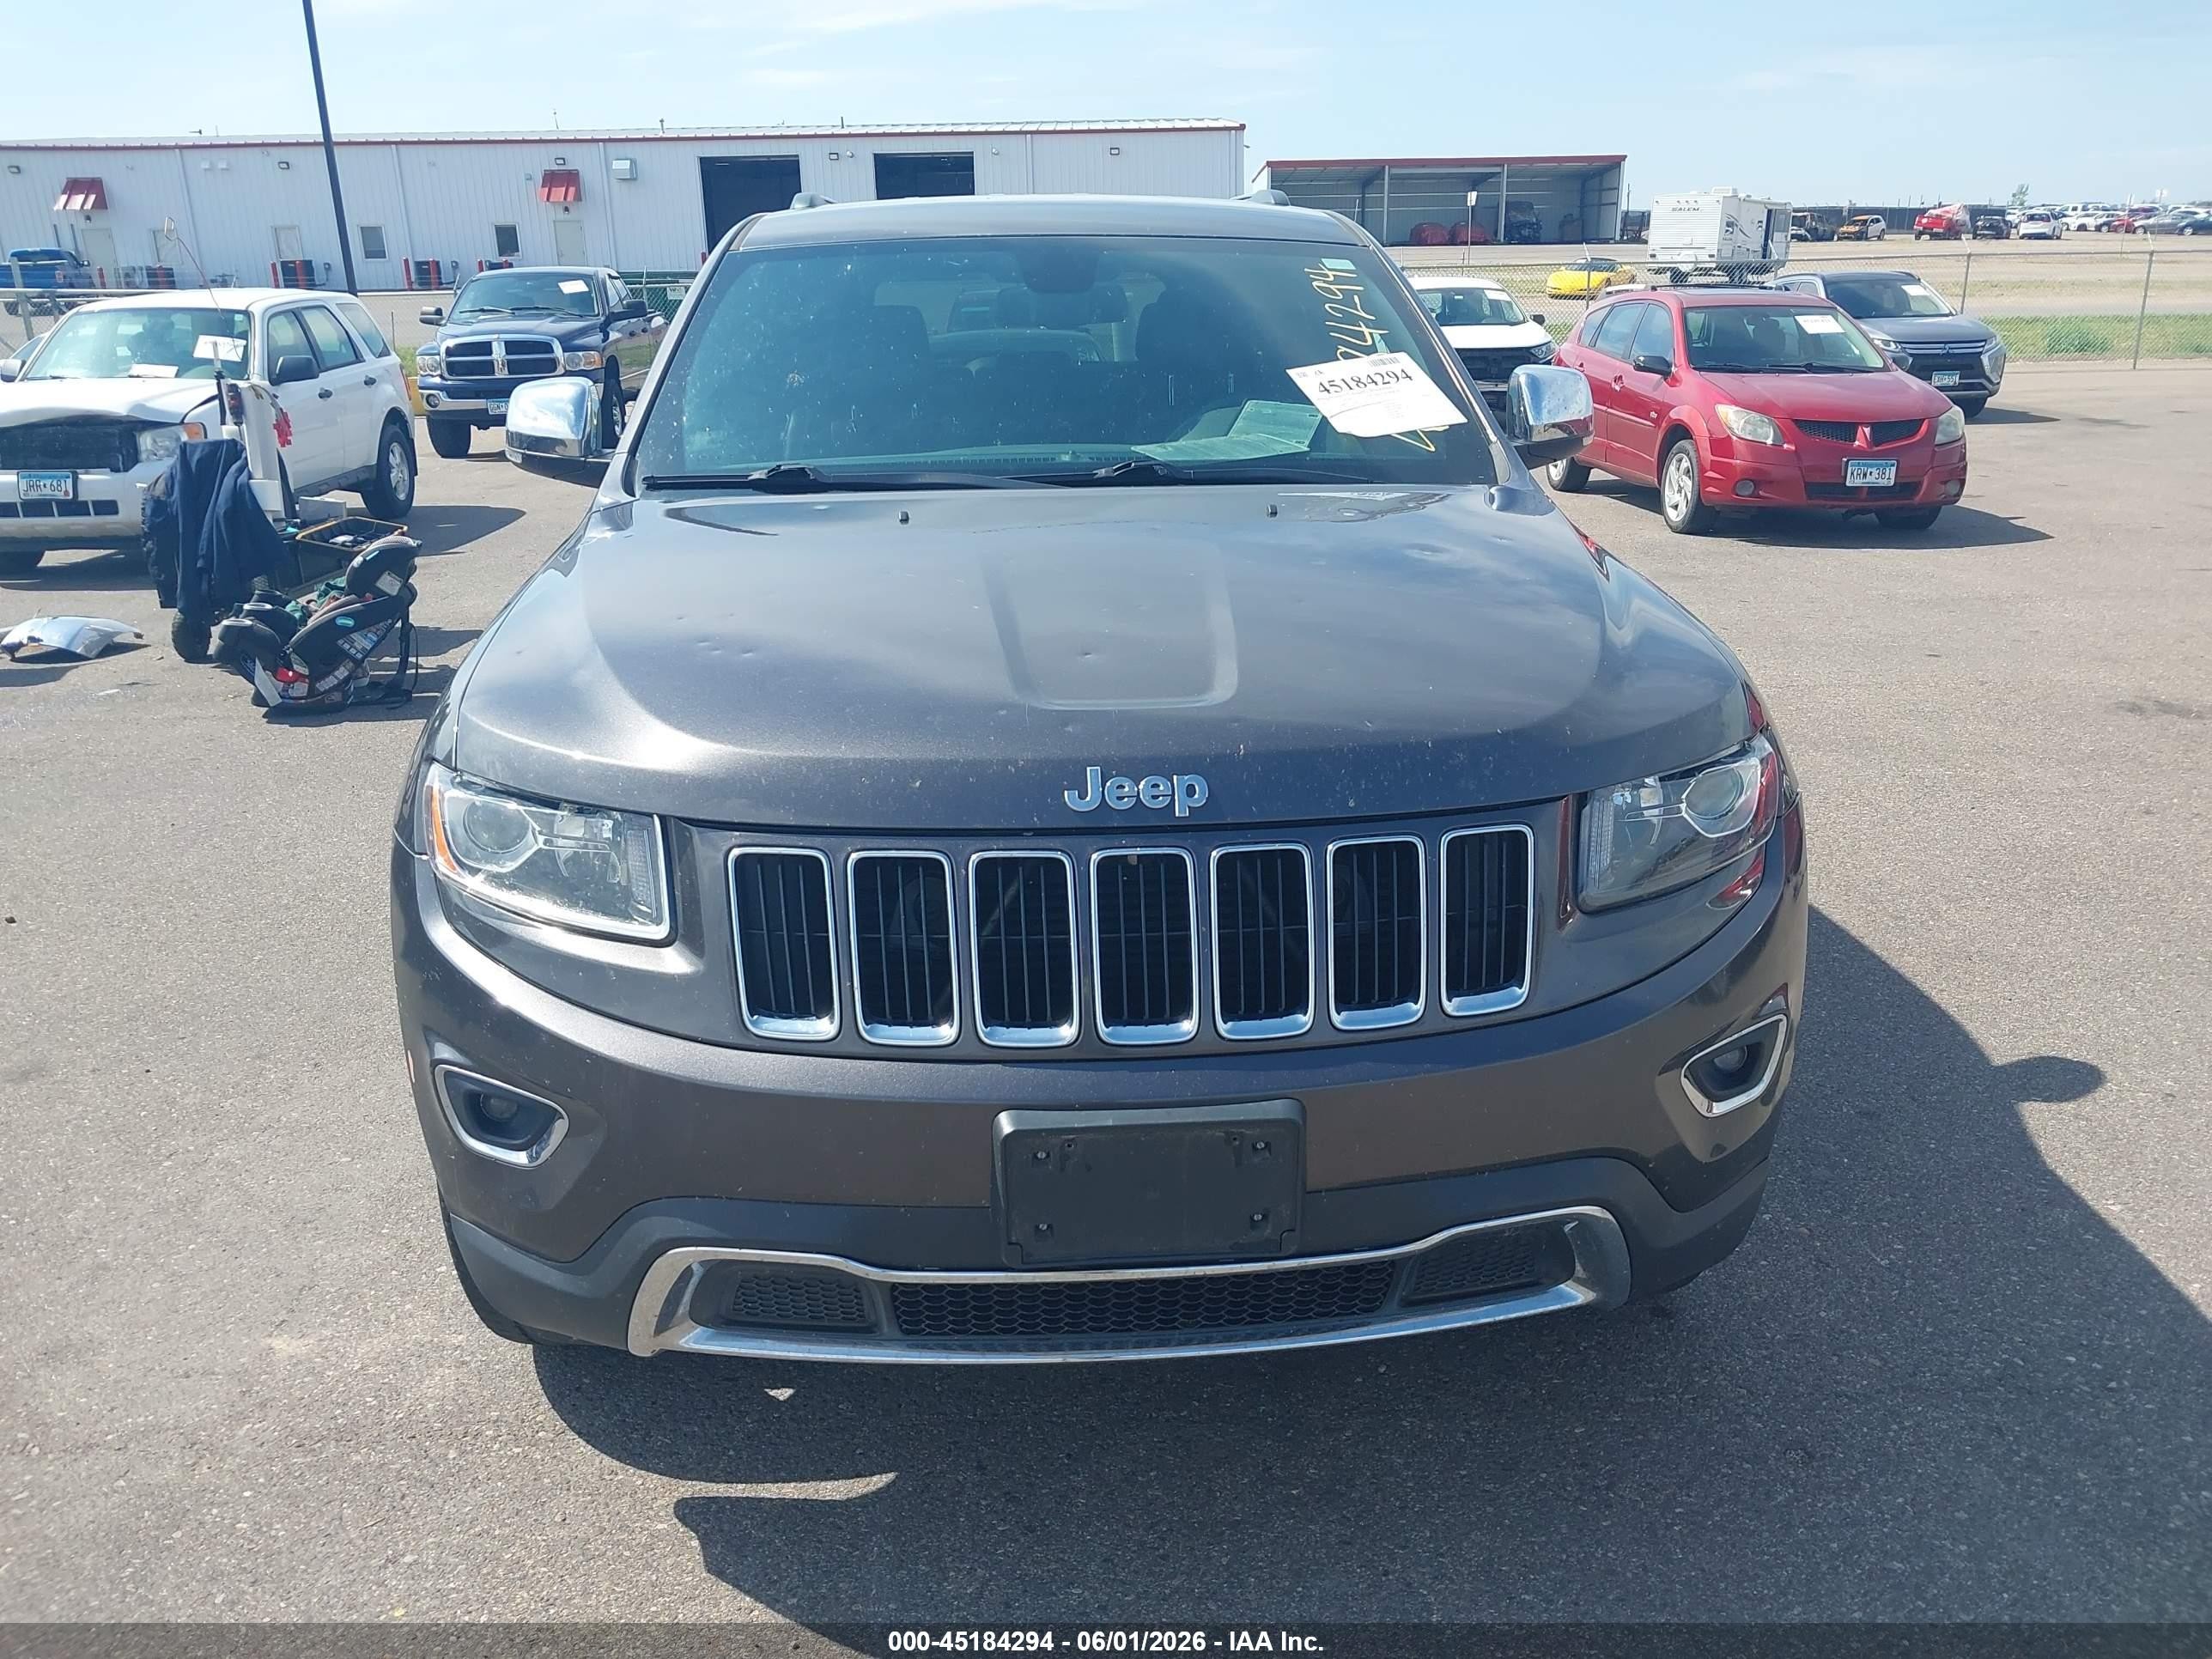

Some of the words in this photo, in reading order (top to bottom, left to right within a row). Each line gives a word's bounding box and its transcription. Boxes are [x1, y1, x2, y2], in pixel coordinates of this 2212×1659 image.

[1318, 368, 1413, 395] 45184294
[1875, 467, 1892, 481] 381
[1064, 766, 1209, 817] Jeep
